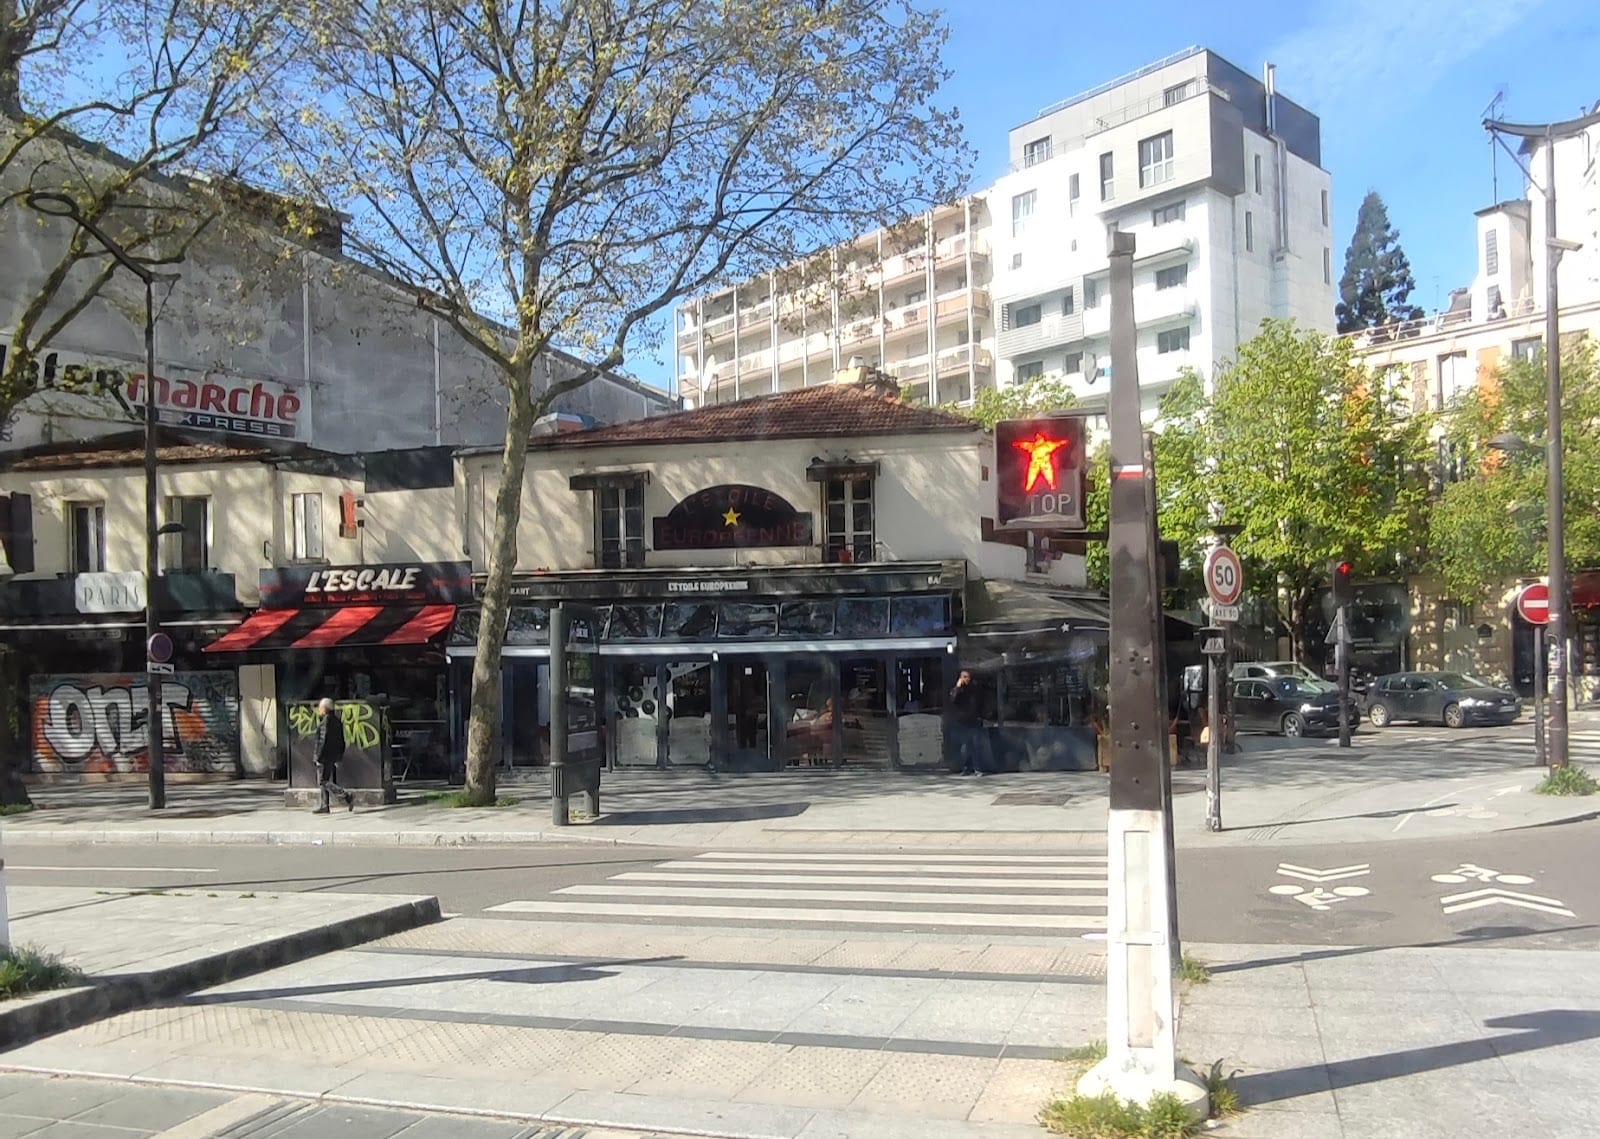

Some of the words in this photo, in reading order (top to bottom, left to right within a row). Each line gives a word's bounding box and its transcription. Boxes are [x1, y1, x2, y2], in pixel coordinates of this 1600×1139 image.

[158, 410, 281, 435] EXPRESS
[305, 567, 421, 593] L'ESCALE
[1215, 565, 1234, 586] 50
[83, 586, 139, 606] PARIS
